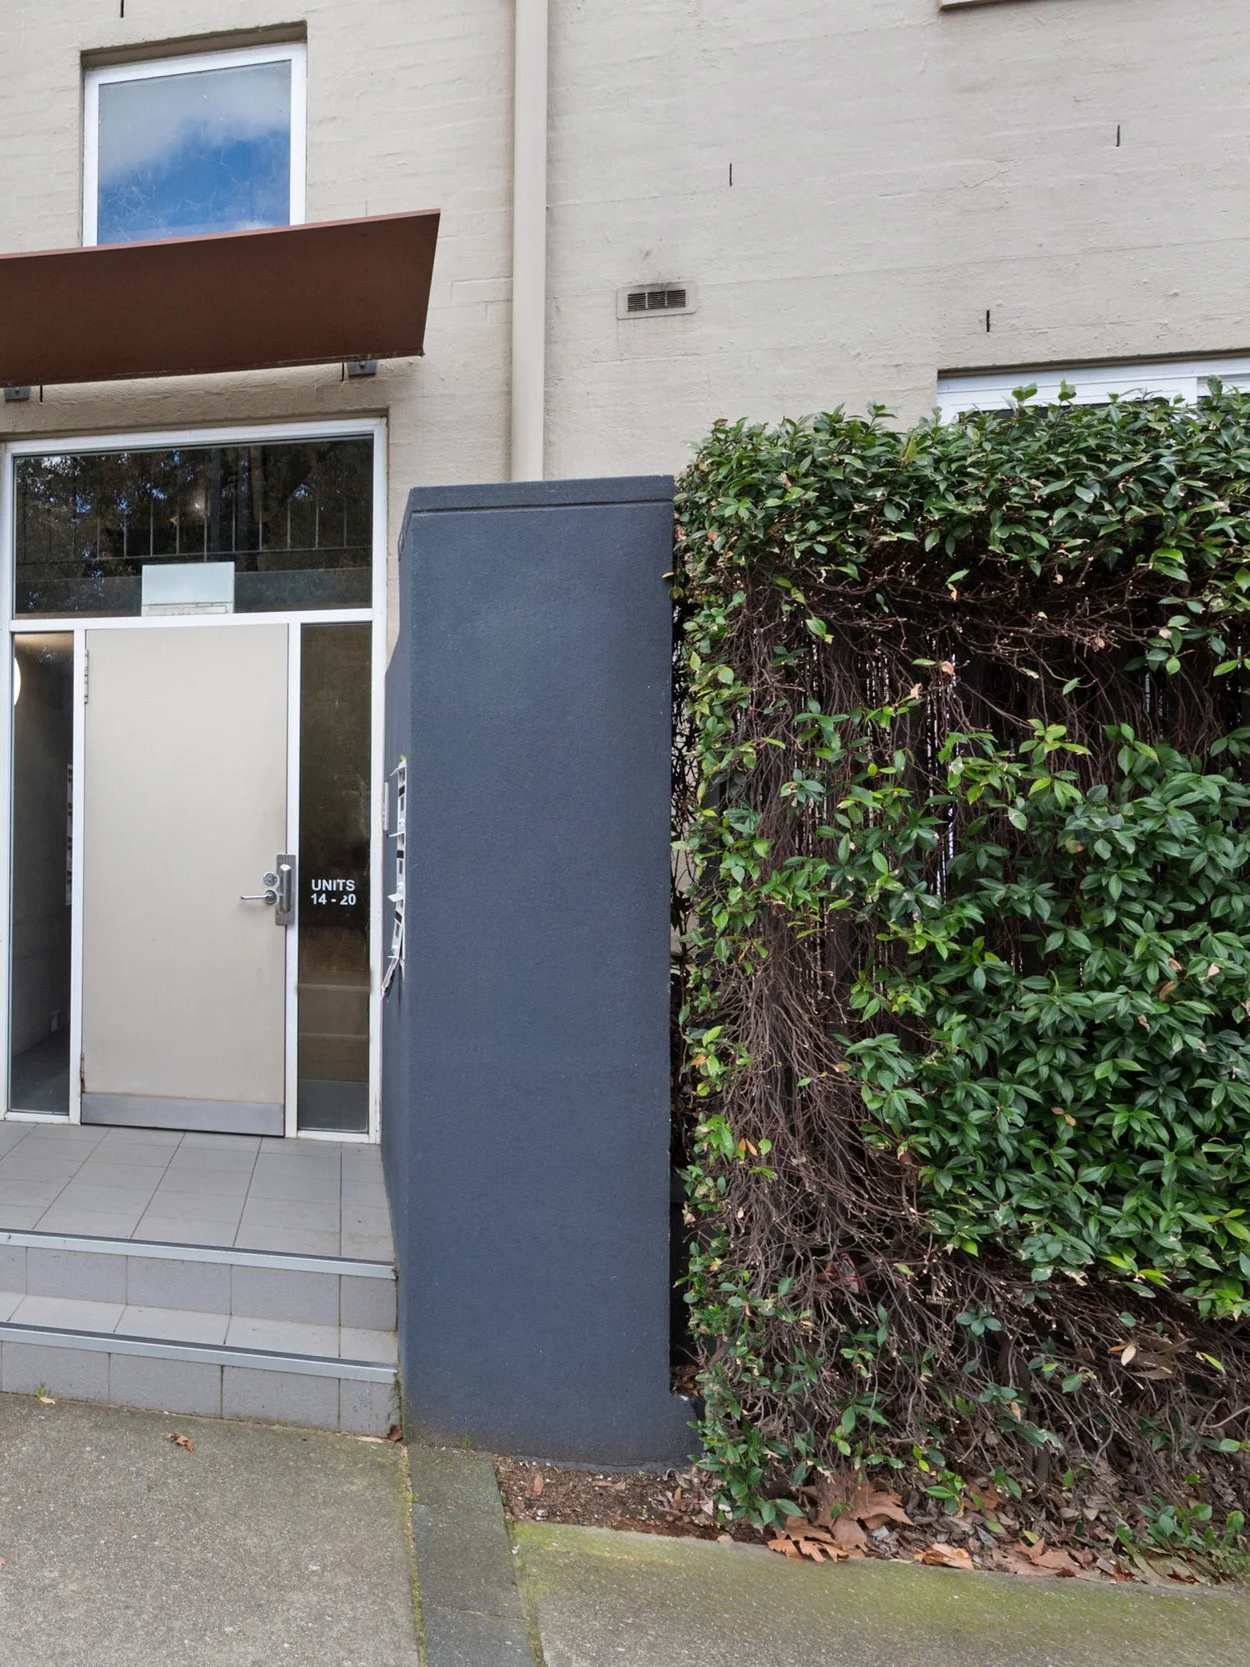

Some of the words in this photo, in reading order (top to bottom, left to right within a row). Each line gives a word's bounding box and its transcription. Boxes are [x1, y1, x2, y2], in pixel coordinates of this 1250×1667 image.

[311, 879, 355, 891] UNITS
[311, 893, 327, 905] 14
[340, 893, 356, 905] 20
